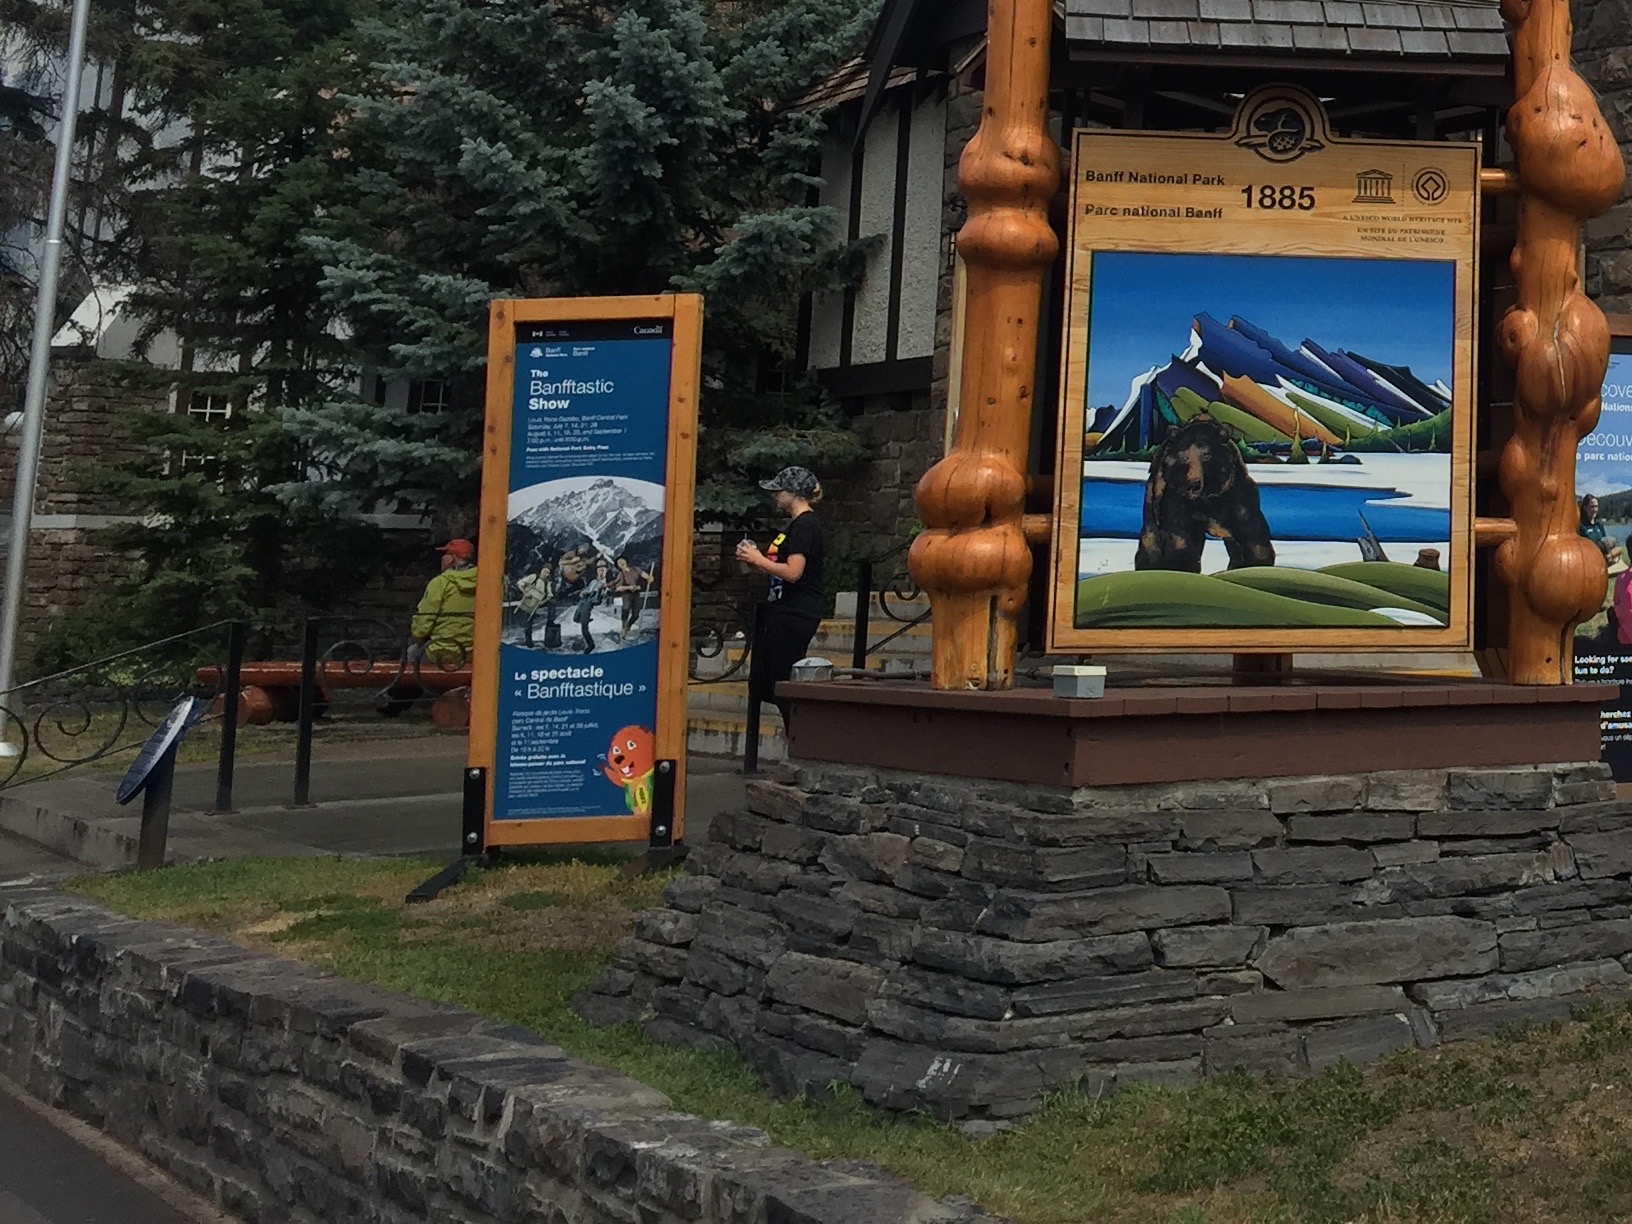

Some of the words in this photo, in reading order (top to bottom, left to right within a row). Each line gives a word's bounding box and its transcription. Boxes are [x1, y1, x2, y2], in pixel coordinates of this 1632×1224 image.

[1085, 170, 1125, 182] Banff
[1128, 171, 1188, 185] National
[1193, 173, 1225, 186] Park
[1241, 184, 1316, 211] 1885
[1085, 204, 1118, 216] Parc
[1122, 205, 1181, 218] national
[1185, 207, 1223, 219] Banff
[530, 369, 549, 377] The
[530, 378, 615, 396] Banfftastic
[528, 397, 570, 410] Show
[1584, 452, 1605, 462] parc
[1574, 655, 1606, 665] Looking
[1607, 655, 1619, 663] for
[514, 672, 527, 681] Le
[530, 665, 604, 682] spectacle
[1600, 665, 1615, 674] do?
[527, 680, 634, 700] Banfftastique
